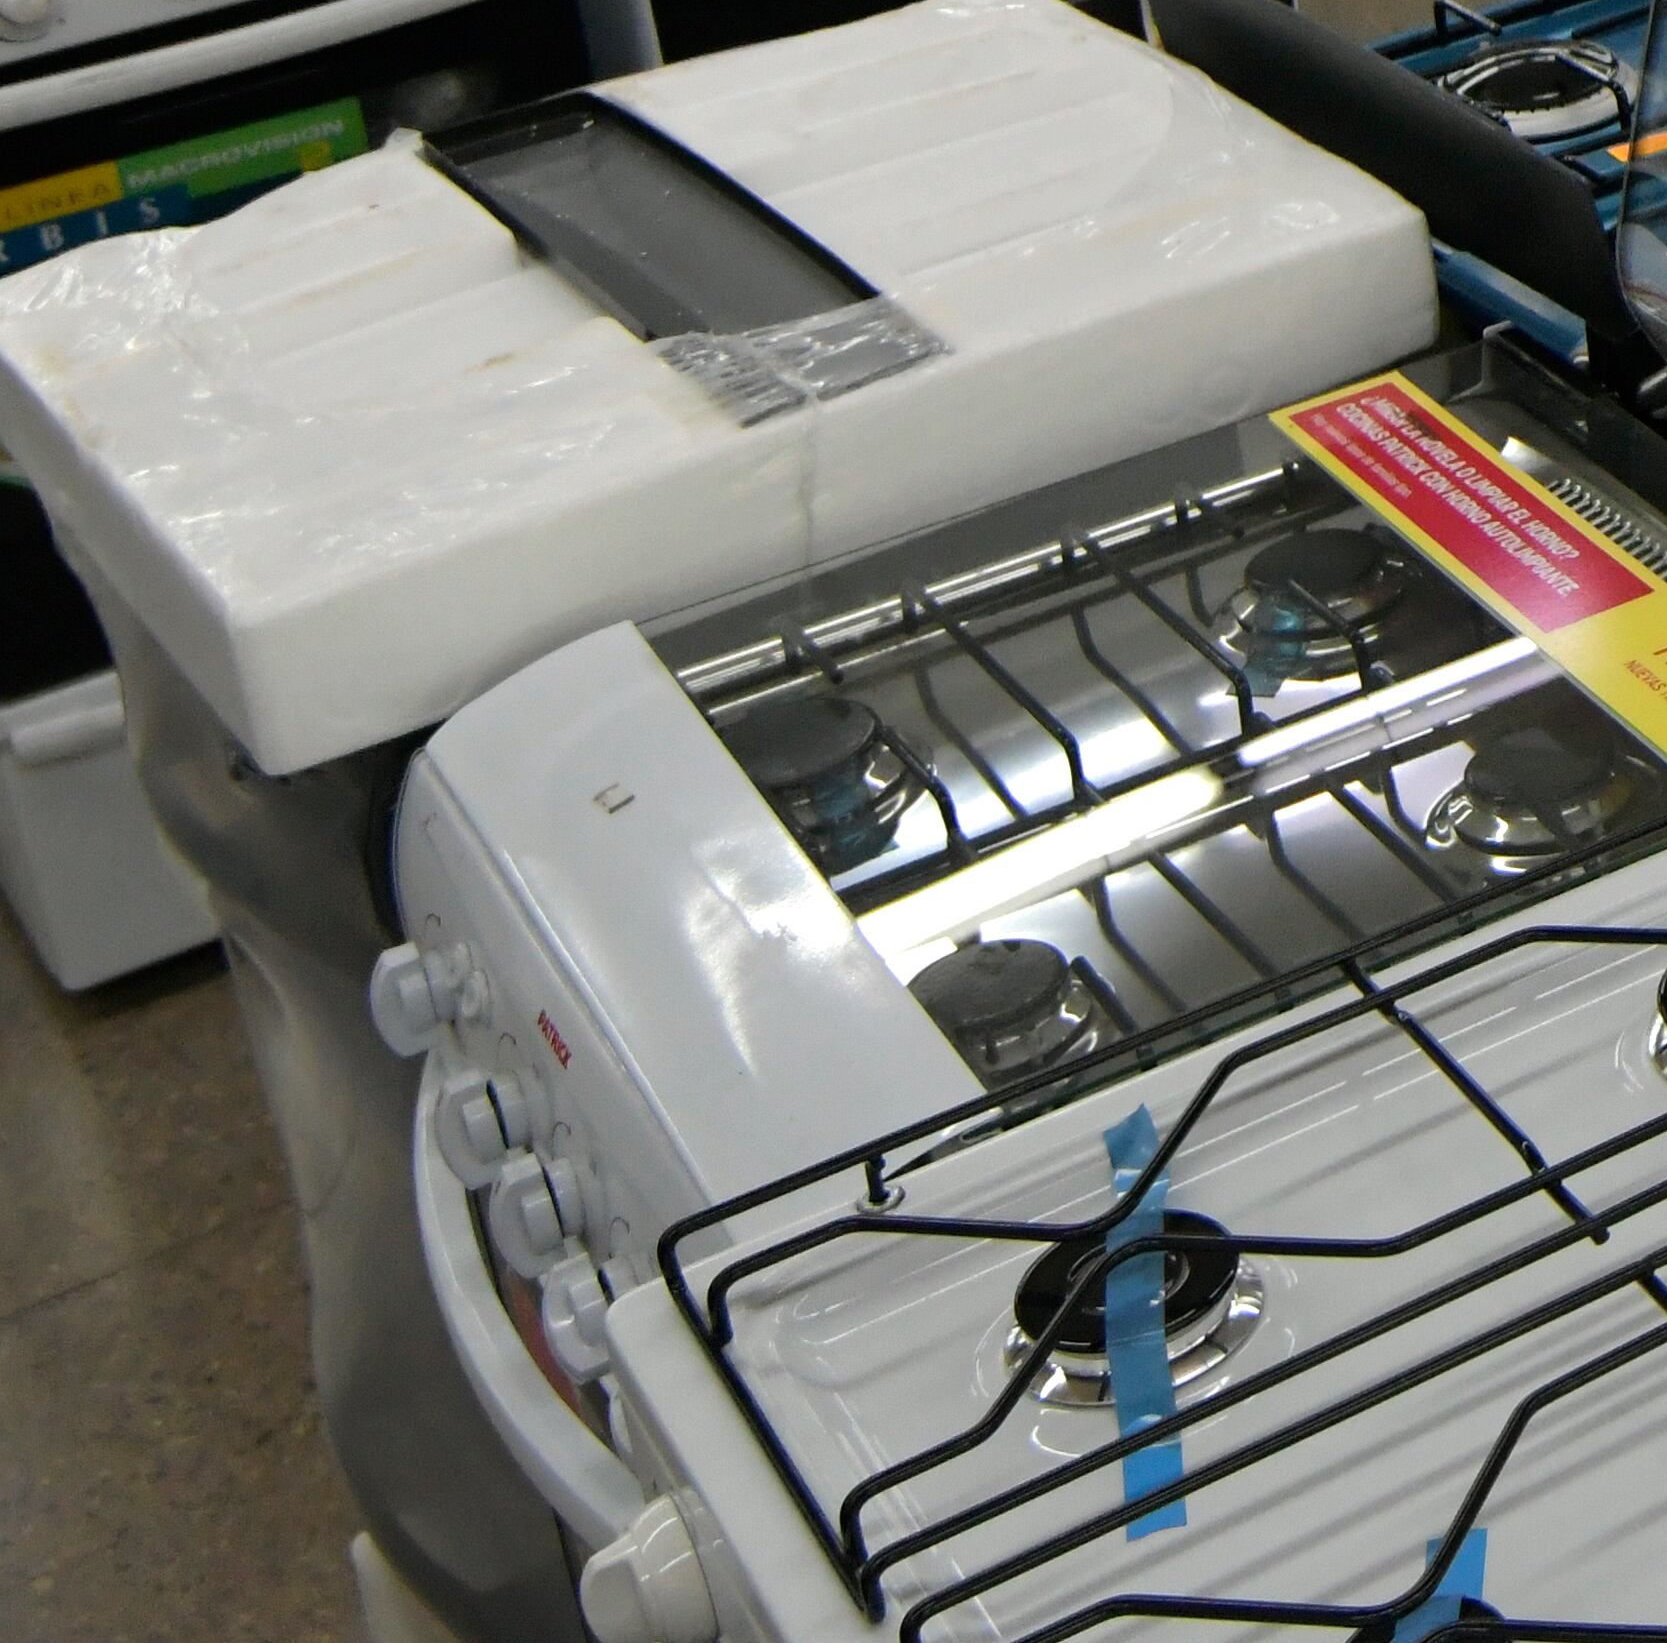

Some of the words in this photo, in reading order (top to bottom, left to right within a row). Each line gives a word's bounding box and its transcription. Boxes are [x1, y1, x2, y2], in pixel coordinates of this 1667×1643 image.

[1336, 402, 1391, 443] COCINAS
[1377, 437, 1433, 477] PATRICK
[1419, 470, 1454, 495] CON
[1442, 488, 1493, 525] HORNO
[1456, 466, 1476, 478] O
[1464, 474, 1520, 513] LIMPIAR
[1506, 508, 1533, 525] EL
[1521, 519, 1581, 561] HORNO?
[1623, 659, 1667, 693] NUEVAS
[536, 1009, 572, 1070] PATRICK
